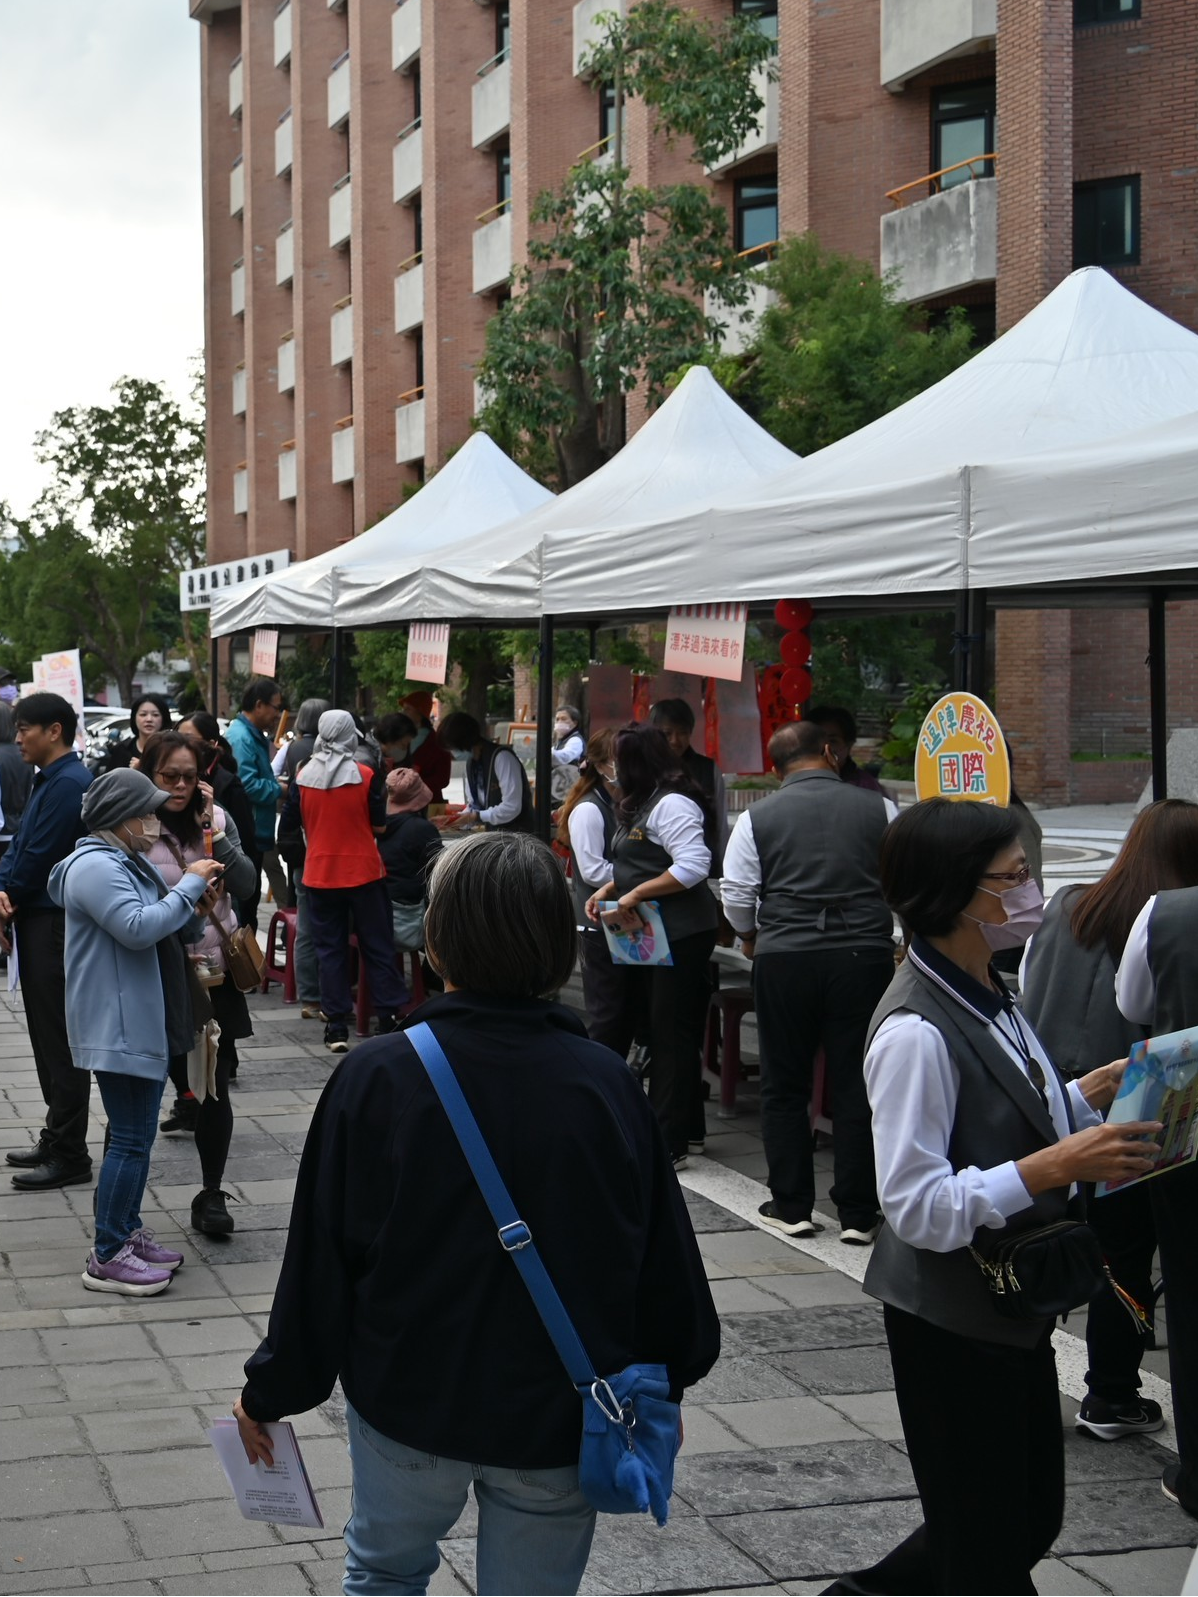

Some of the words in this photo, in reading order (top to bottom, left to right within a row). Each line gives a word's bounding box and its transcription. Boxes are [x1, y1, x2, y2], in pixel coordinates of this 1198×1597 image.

[669, 631, 740, 660] 漂洋過海來看你
[922, 702, 996, 756] 逗陣慶祝
[938, 752, 986, 793] 國際
